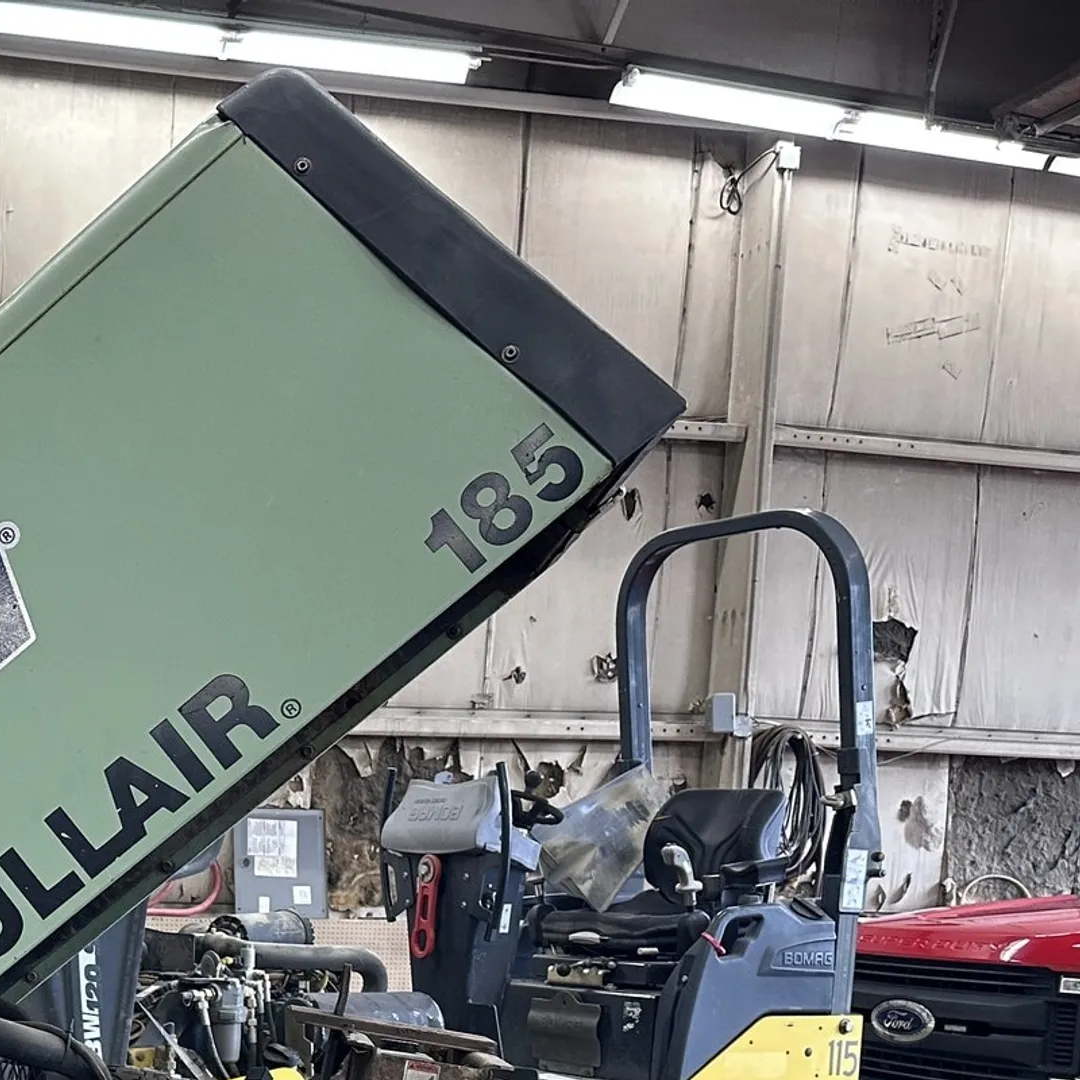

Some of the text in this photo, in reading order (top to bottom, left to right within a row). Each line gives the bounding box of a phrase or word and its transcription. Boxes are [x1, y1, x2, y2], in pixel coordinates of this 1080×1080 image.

[424, 422, 584, 575] 185
[783, 951, 834, 966] BOMAG
[883, 1009, 914, 1031] Ford
[828, 1039, 859, 1077] 115
